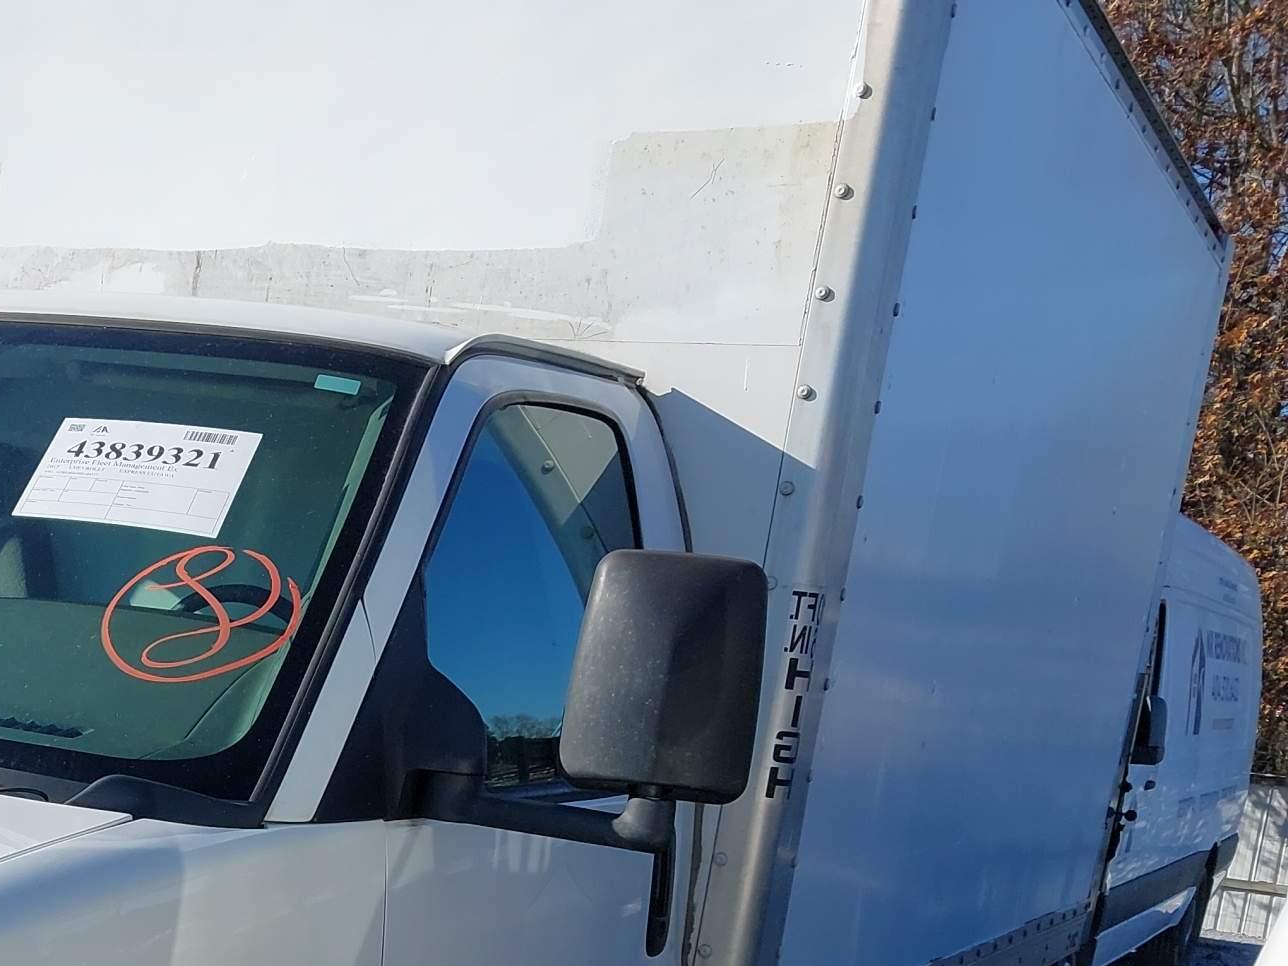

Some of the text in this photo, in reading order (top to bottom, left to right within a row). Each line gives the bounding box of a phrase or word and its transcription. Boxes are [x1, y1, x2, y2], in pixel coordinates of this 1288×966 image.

[50, 457, 90, 468] Enterprise
[112, 461, 165, 472] Management
[67, 440, 222, 469] 43839321
[142, 546, 282, 669] 8
